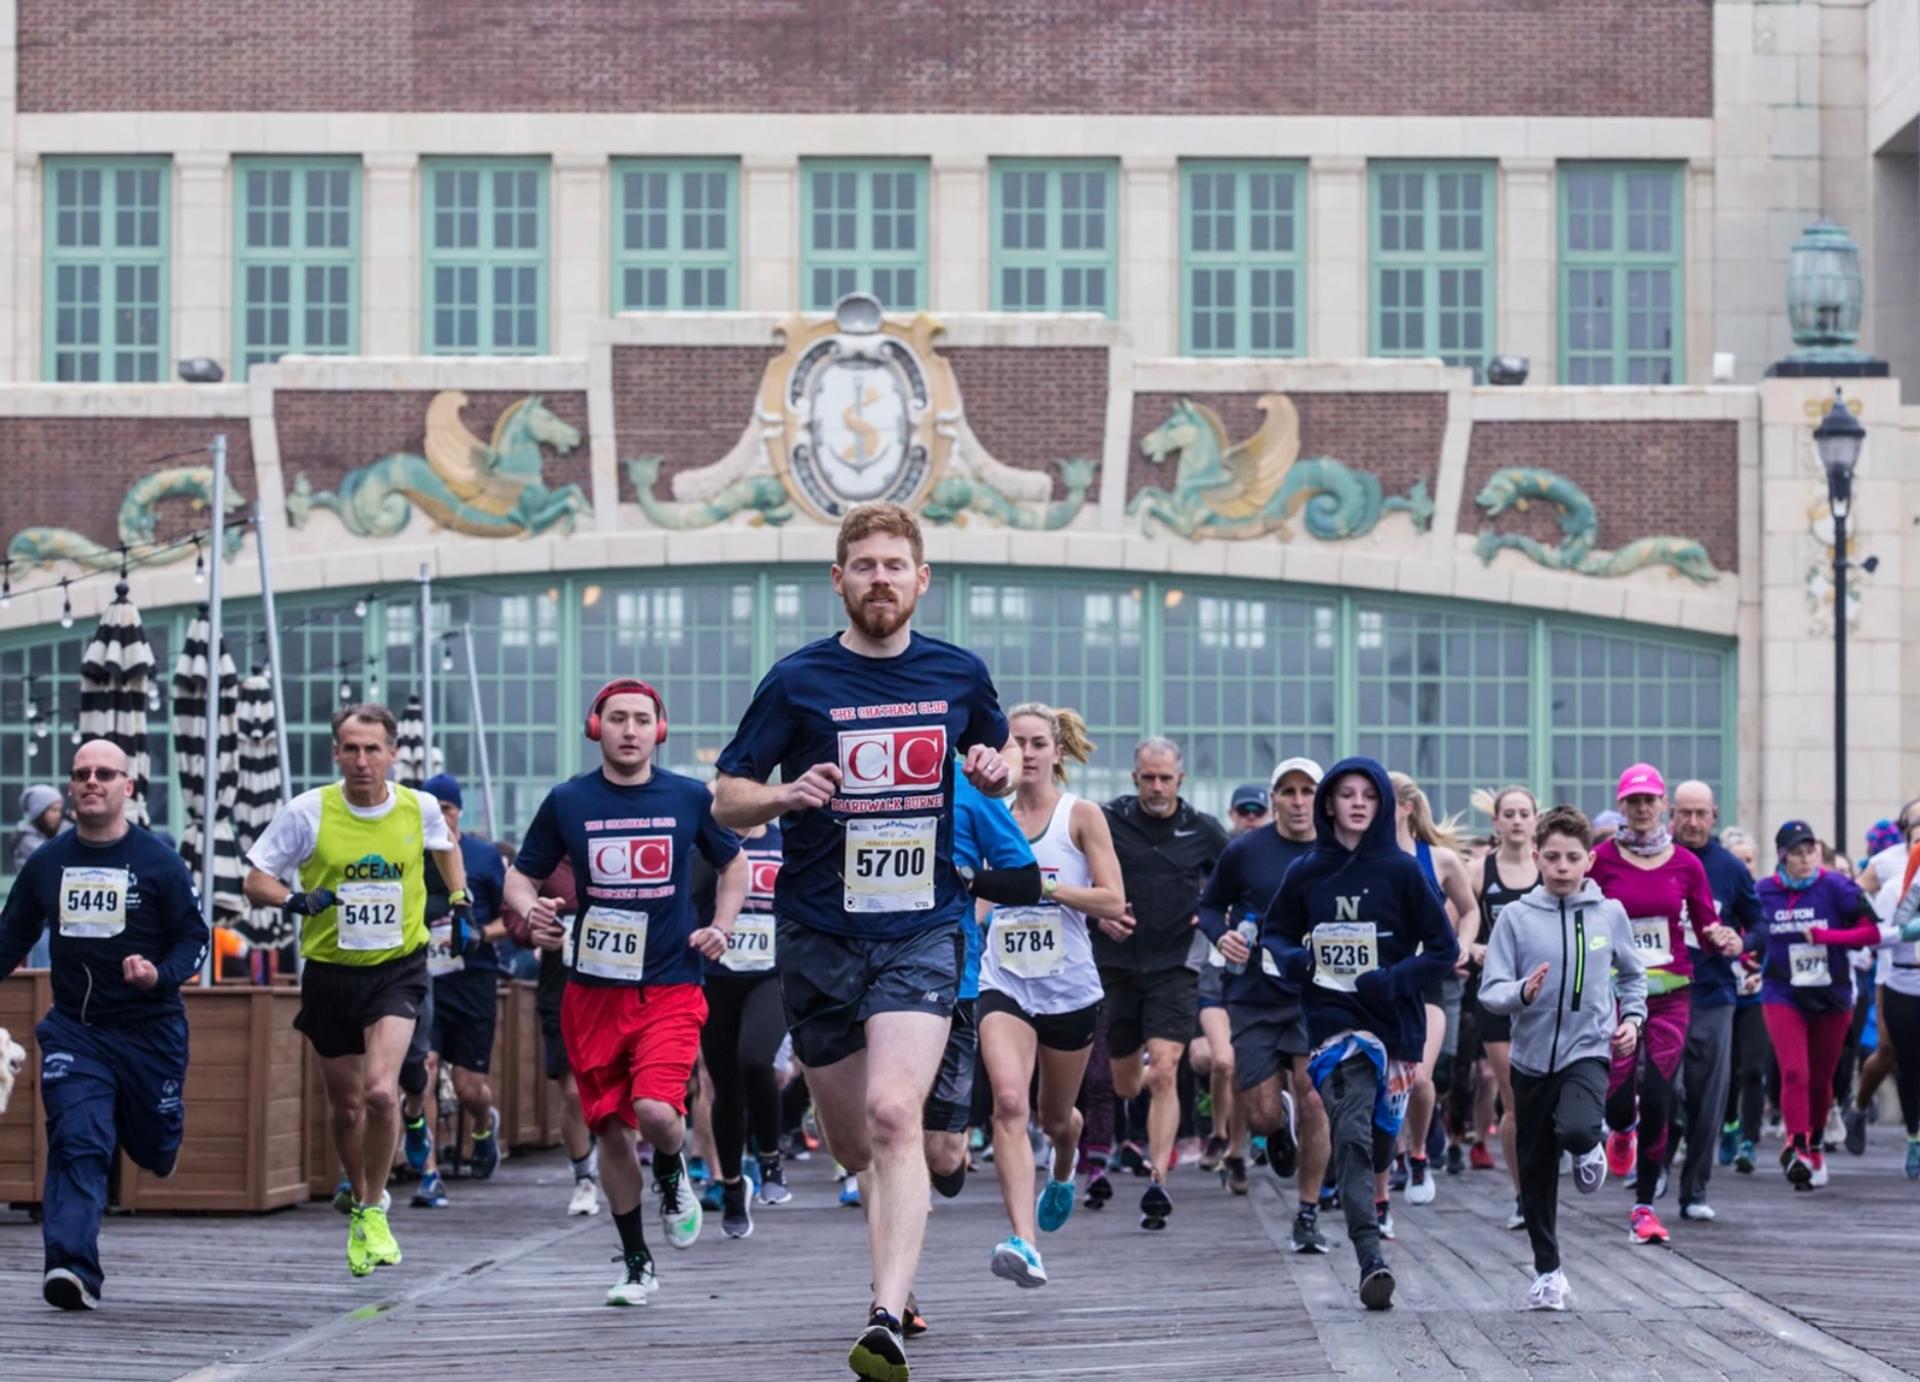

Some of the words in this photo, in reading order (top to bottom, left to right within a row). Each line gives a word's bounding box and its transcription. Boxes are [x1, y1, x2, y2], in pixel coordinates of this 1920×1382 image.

[830, 708, 856, 720] THE
[857, 703, 917, 719] CHATHAM
[918, 700, 948, 714] CLUB
[831, 797, 902, 813] BOARDWALK
[344, 862, 404, 880] OCEAN
[856, 847, 925, 878] 5700
[68, 890, 118, 912] 5449
[1335, 896, 1361, 920] N
[345, 903, 396, 925] 5412
[586, 927, 638, 955] 5716
[727, 932, 768, 951] 5770
[1004, 929, 1055, 954] 5784
[1320, 945, 1369, 966] 5236
